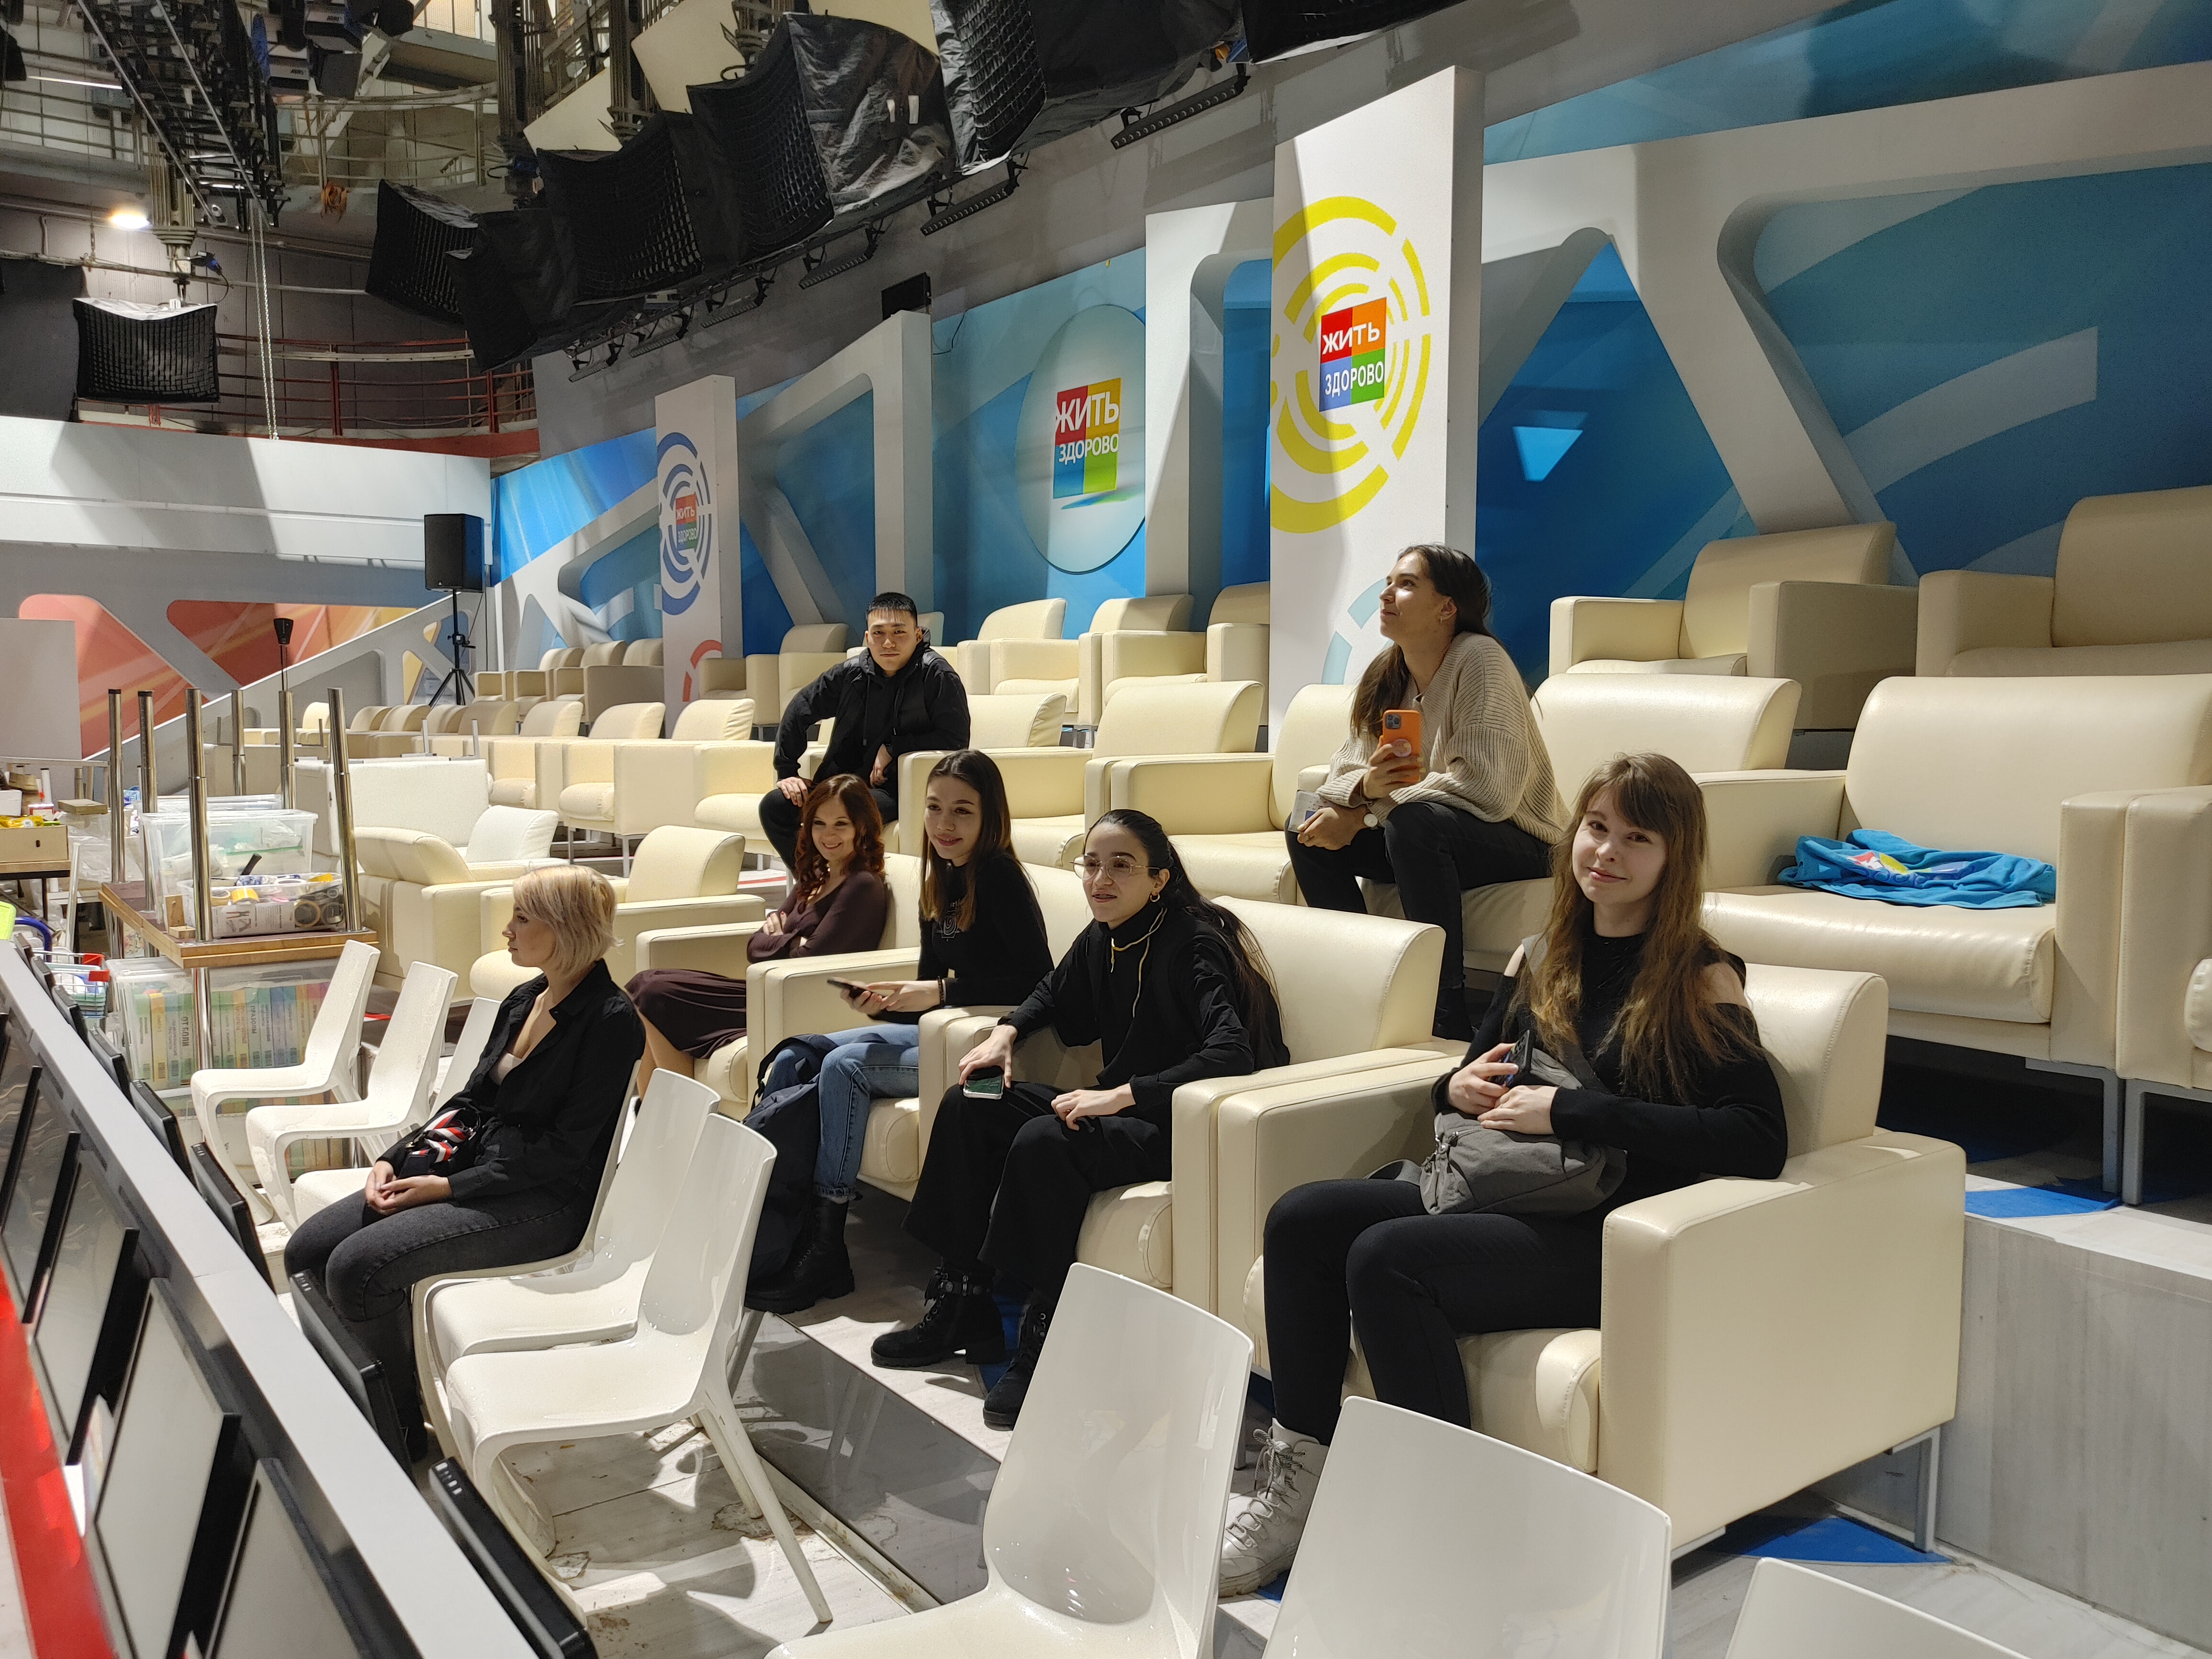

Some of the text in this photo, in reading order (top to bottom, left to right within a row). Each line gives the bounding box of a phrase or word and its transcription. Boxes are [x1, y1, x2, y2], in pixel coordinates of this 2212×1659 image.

[1322, 322, 1381, 355] ЖИТЬ
[1325, 361, 1384, 398] ЗДОРОВО
[1054, 391, 1119, 434] ЖИТЬ
[1058, 433, 1119, 465] ЗДОРОВО
[676, 507, 695, 520] ЖИТЬ
[678, 528, 697, 544] ЗДОРОВО
[182, 1016, 189, 1025] ОТ
